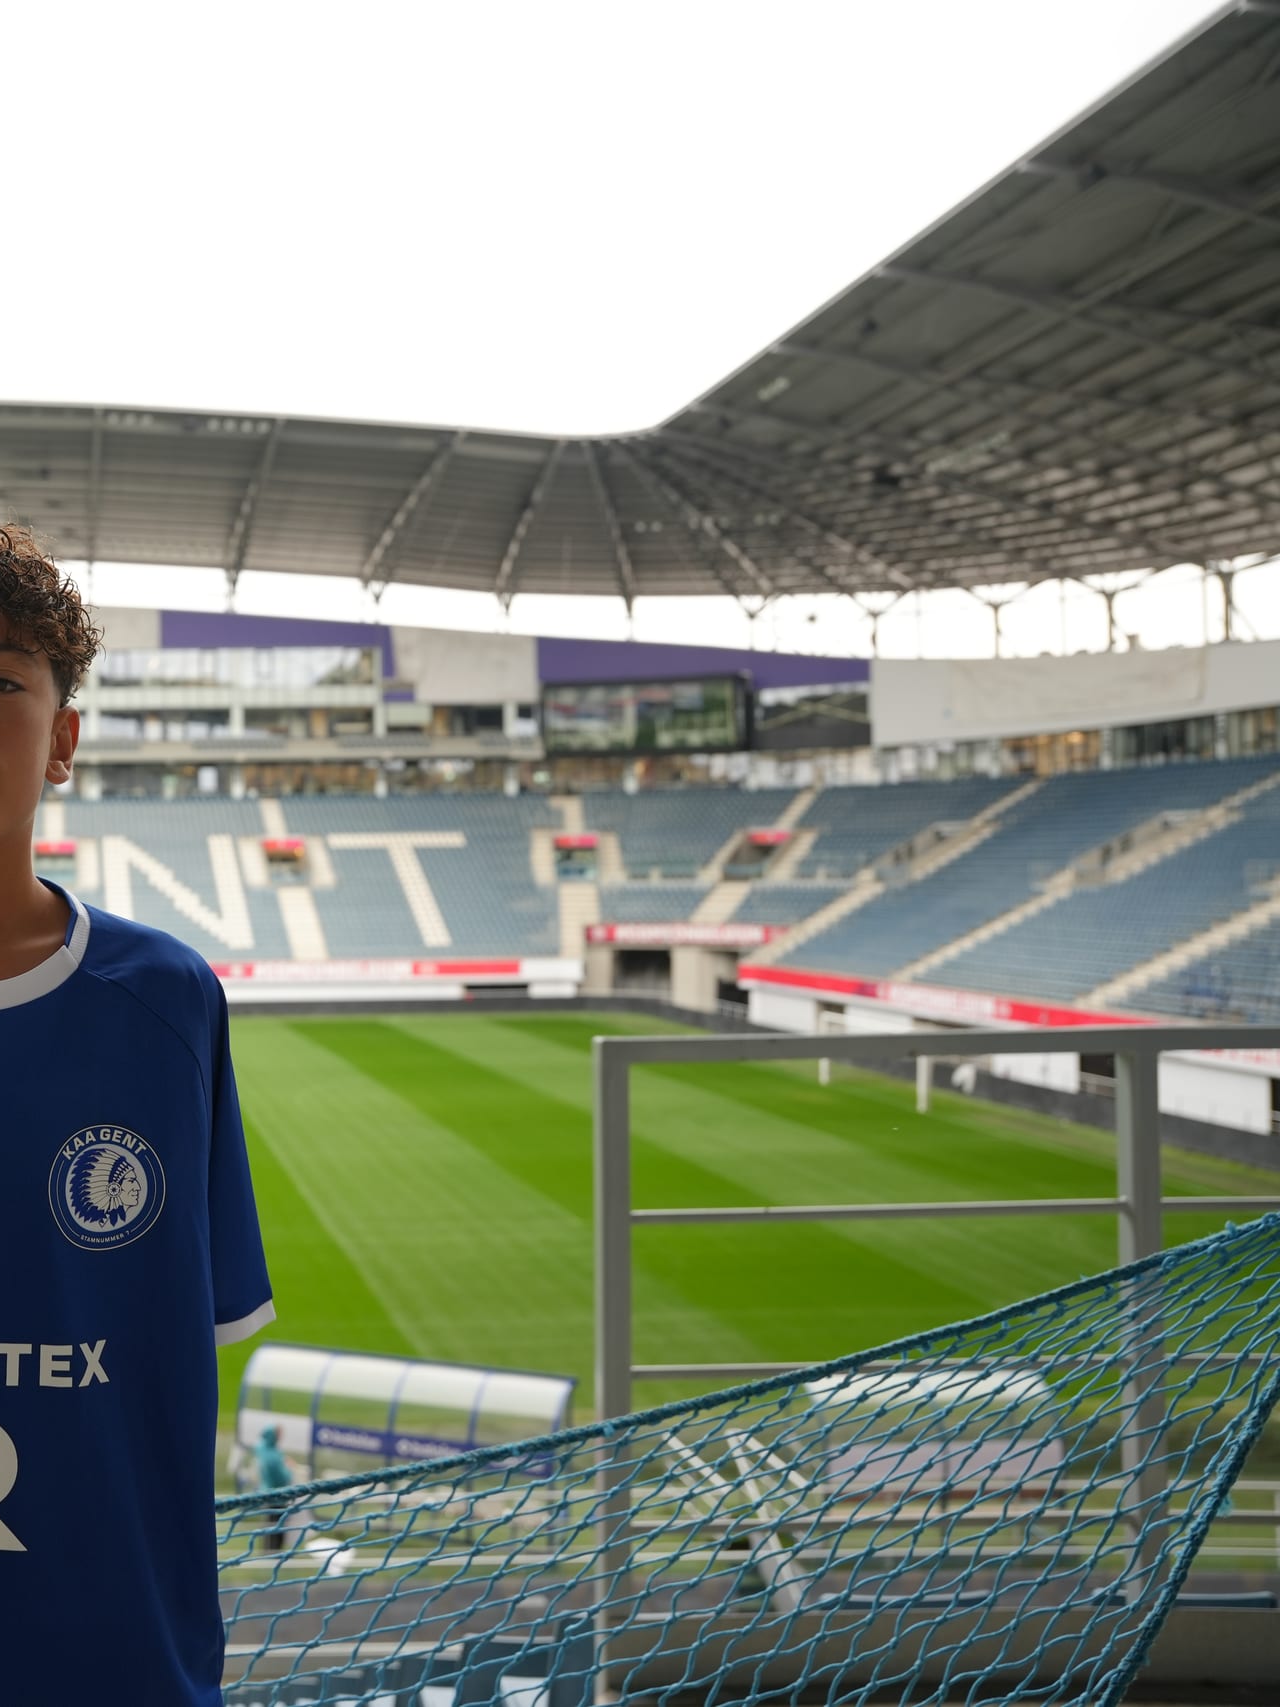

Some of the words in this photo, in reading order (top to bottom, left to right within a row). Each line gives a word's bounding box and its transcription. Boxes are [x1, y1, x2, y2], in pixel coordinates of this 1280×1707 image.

[61, 1130, 97, 1161] KAA
[99, 1128, 147, 1156] GENT
[80, 1233, 125, 1243] STAMNUMMER
